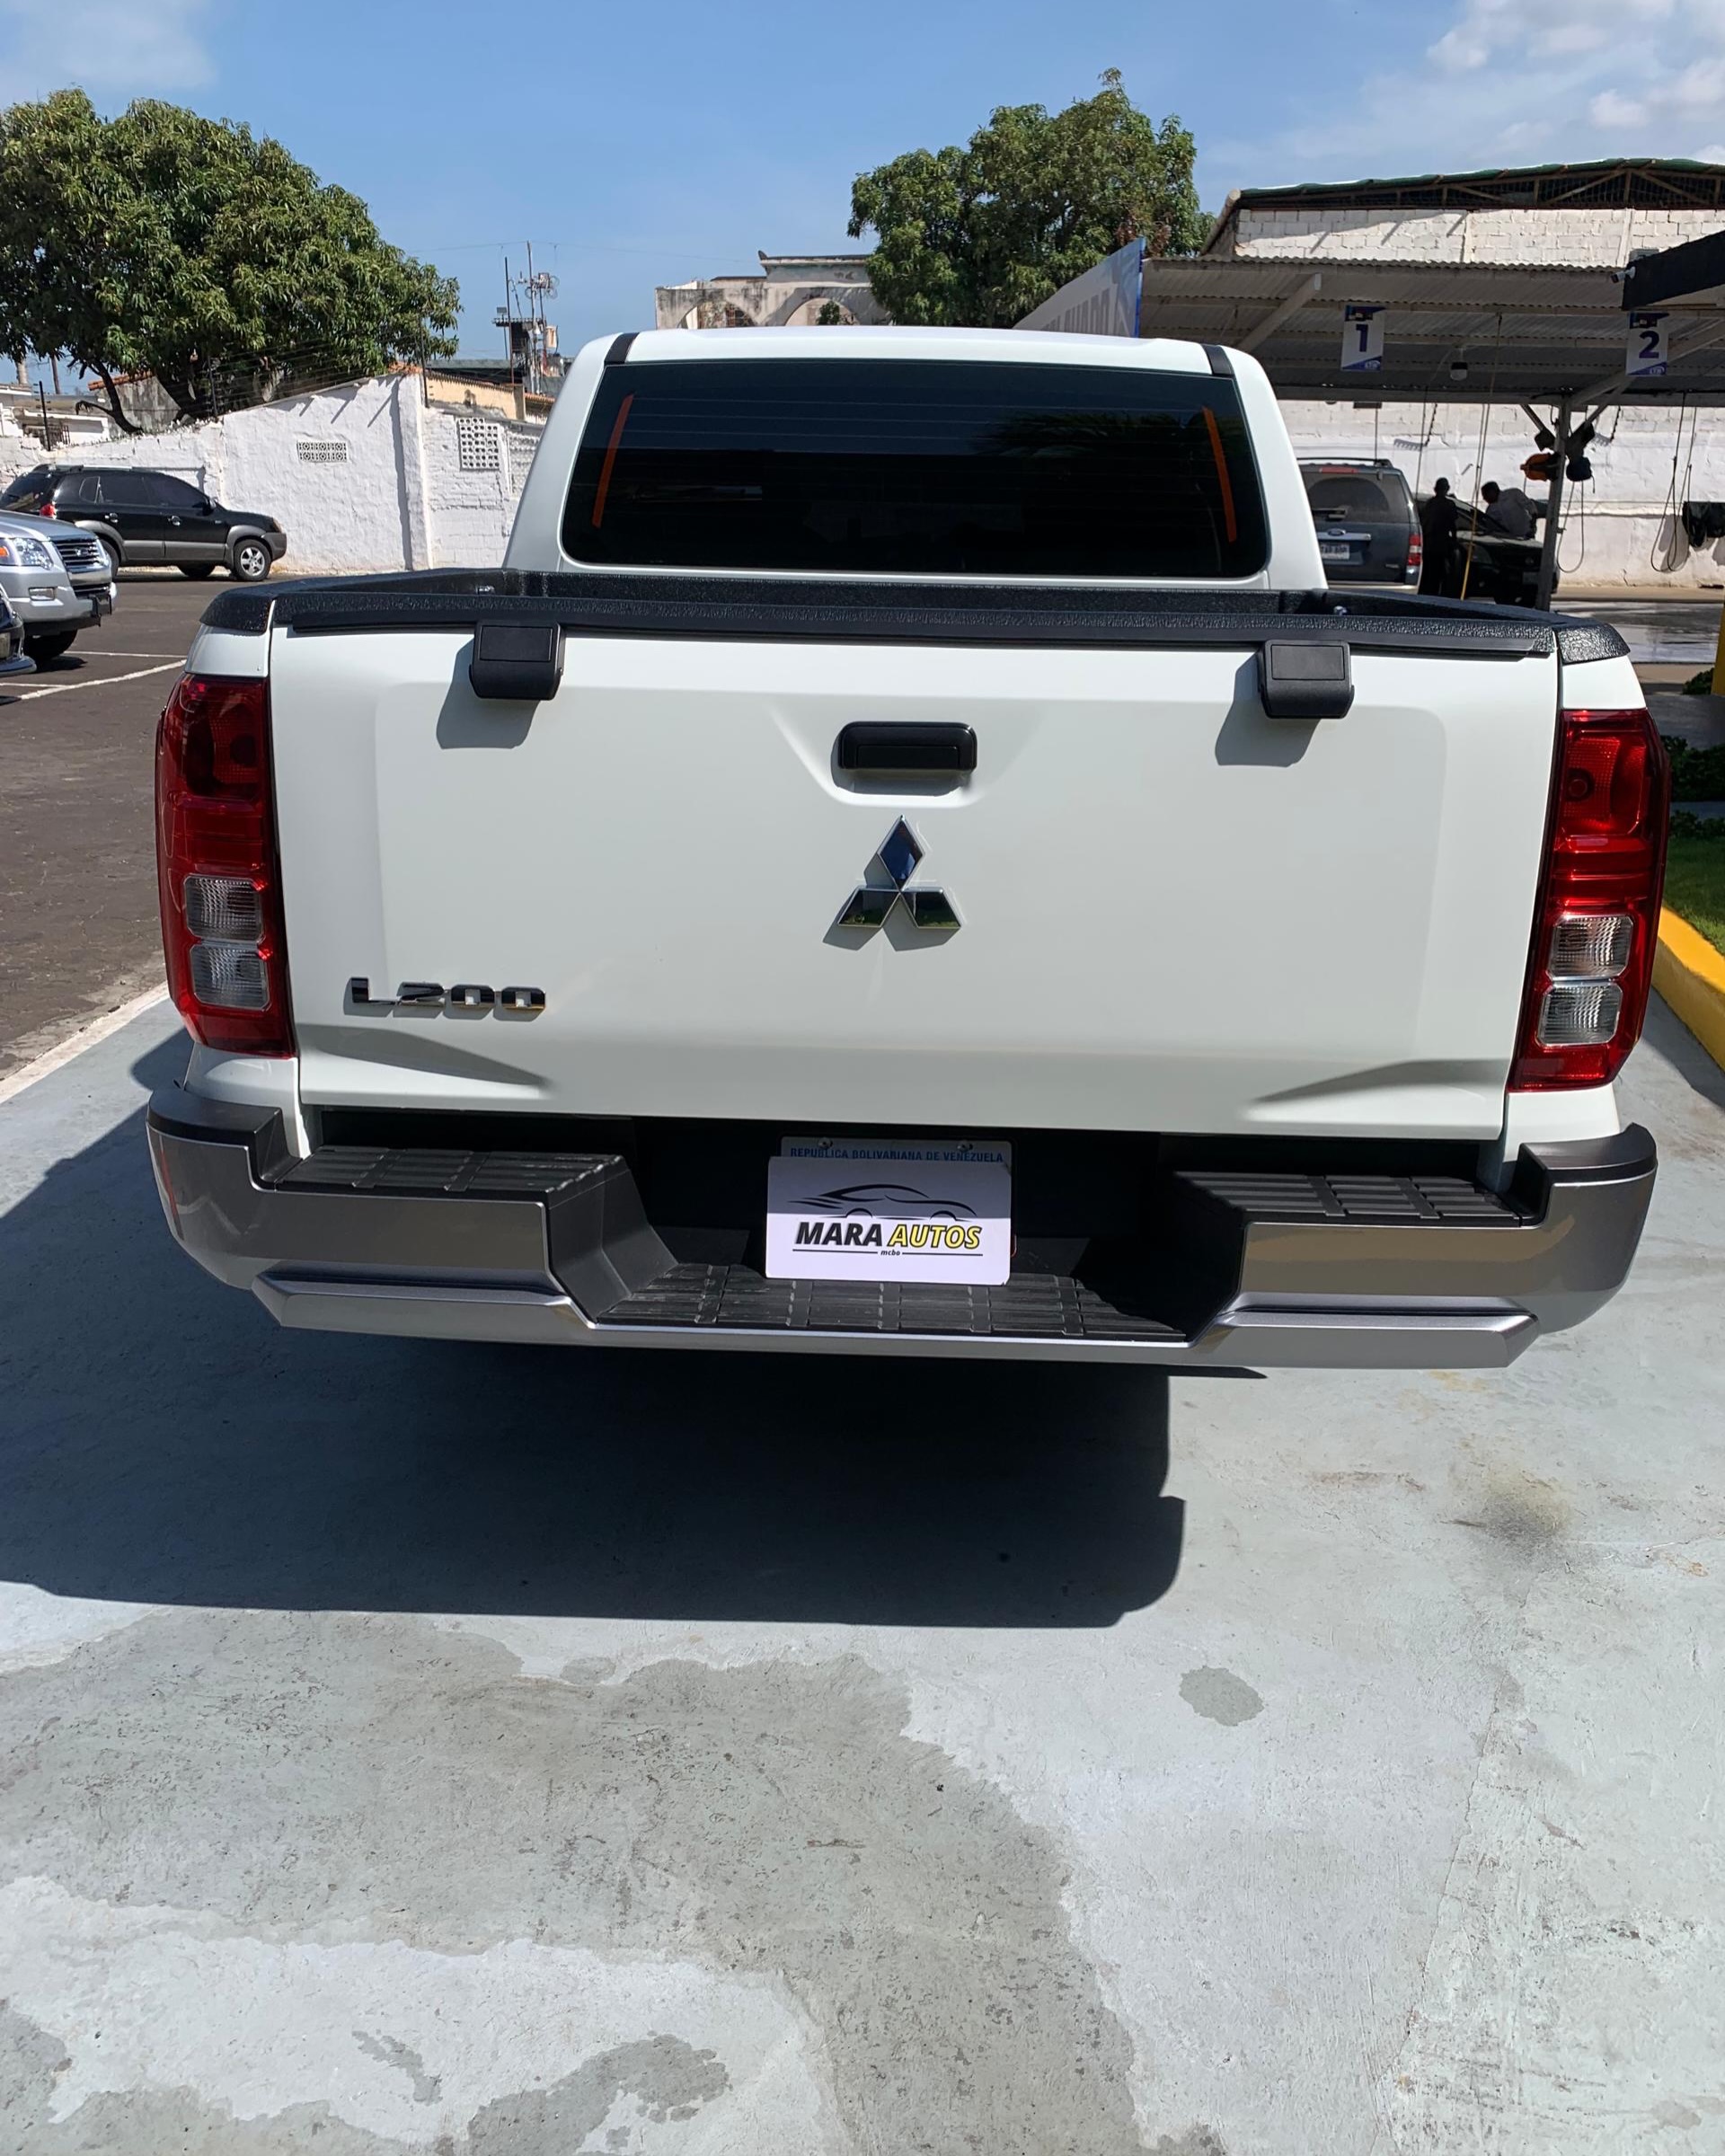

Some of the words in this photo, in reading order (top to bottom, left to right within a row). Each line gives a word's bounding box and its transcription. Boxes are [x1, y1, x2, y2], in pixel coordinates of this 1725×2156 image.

[1356, 324, 1368, 352] 1
[1639, 331, 1659, 358] 2
[350, 976, 546, 1010] L200
[852, 1149, 922, 1160] BOLIVARIANA
[925, 1151, 940, 1162] DE
[943, 1151, 1004, 1162] VENEZUELA
[795, 1222, 883, 1247] MARA
[886, 1224, 982, 1250] AUTOS
